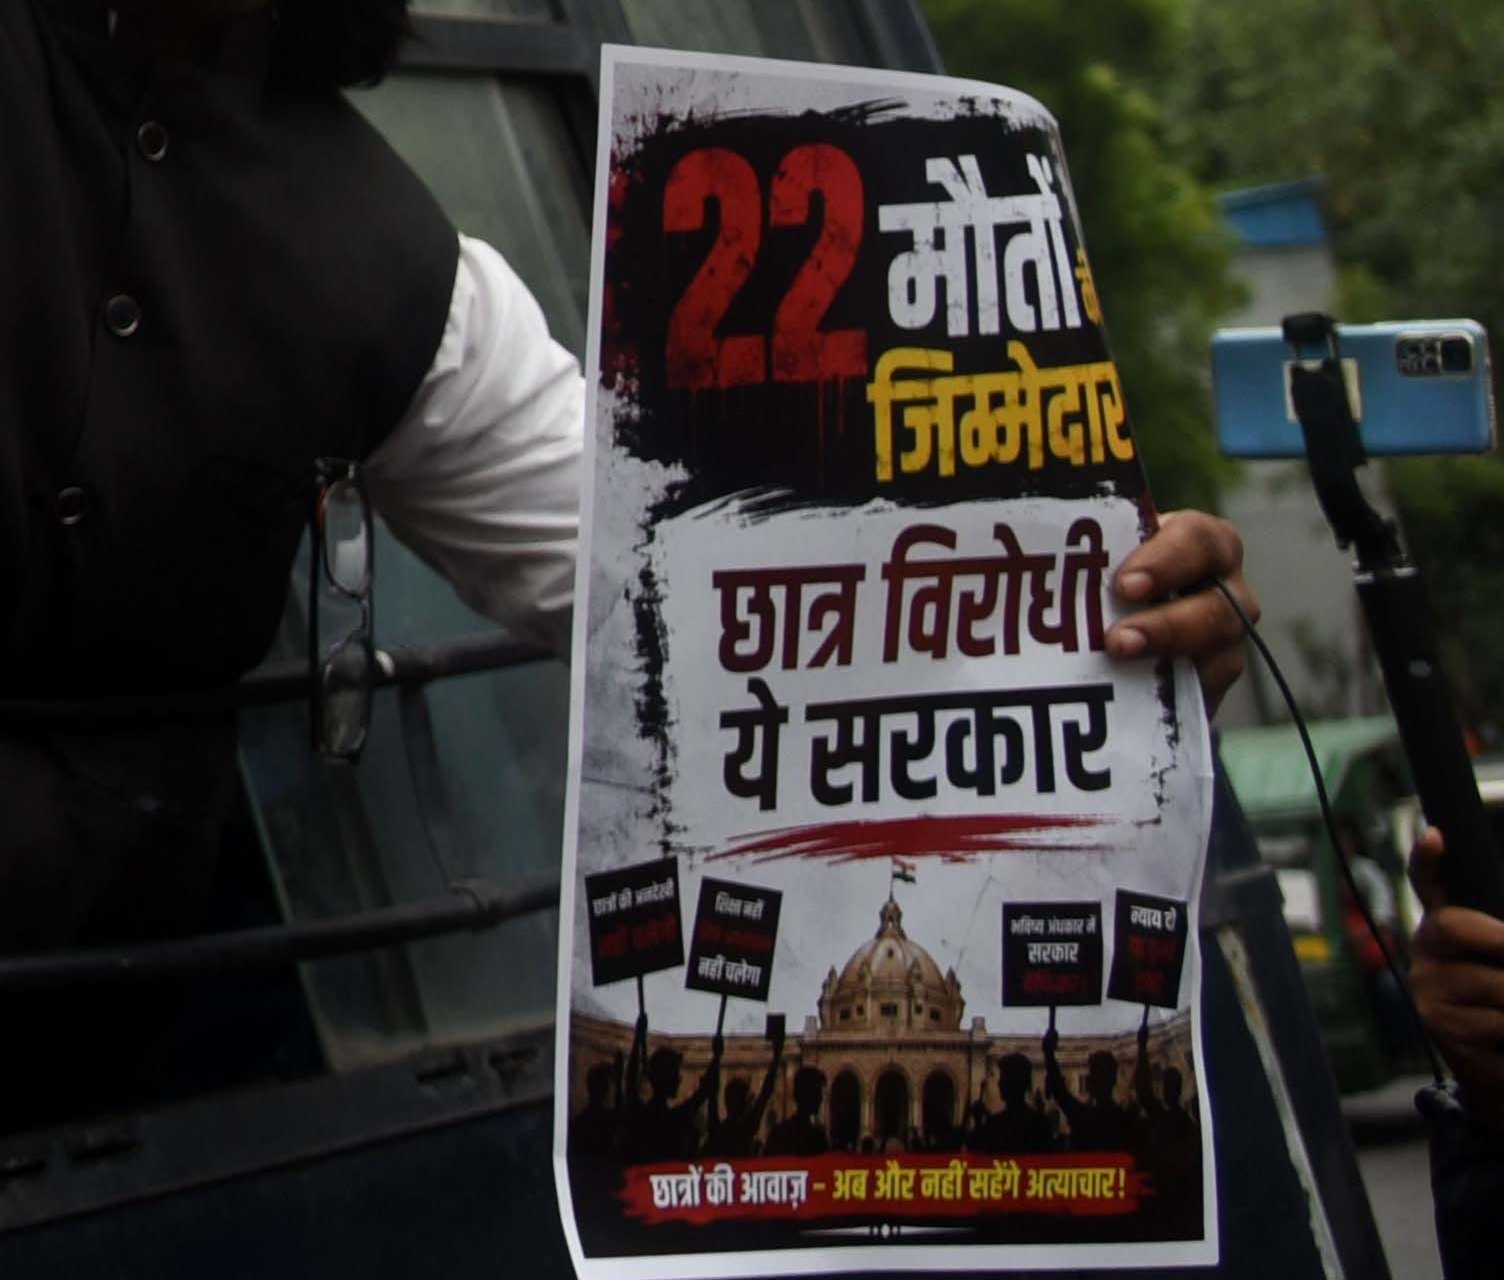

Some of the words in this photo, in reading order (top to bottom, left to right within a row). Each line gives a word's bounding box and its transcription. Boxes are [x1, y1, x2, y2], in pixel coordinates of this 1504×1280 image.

[662, 142, 868, 391] 22
[878, 152, 1082, 336] मौतों
[866, 339, 1135, 481] जिम्मेदार
[712, 563, 867, 673] छात्र
[881, 516, 1109, 663] विरोधी
[719, 676, 789, 811] ये
[804, 682, 1115, 807] सरकार
[1027, 942, 1079, 963] सरकार
[1130, 905, 1162, 931] न्याय
[649, 1163, 702, 1209] छात्रों
[703, 1162, 734, 1205] की
[741, 1170, 809, 1210] आवाज़
[832, 1168, 869, 1200] अब
[874, 1159, 916, 1200] और
[919, 1158, 968, 1200] नहीं
[968, 1159, 1022, 1200] सहेंगे
